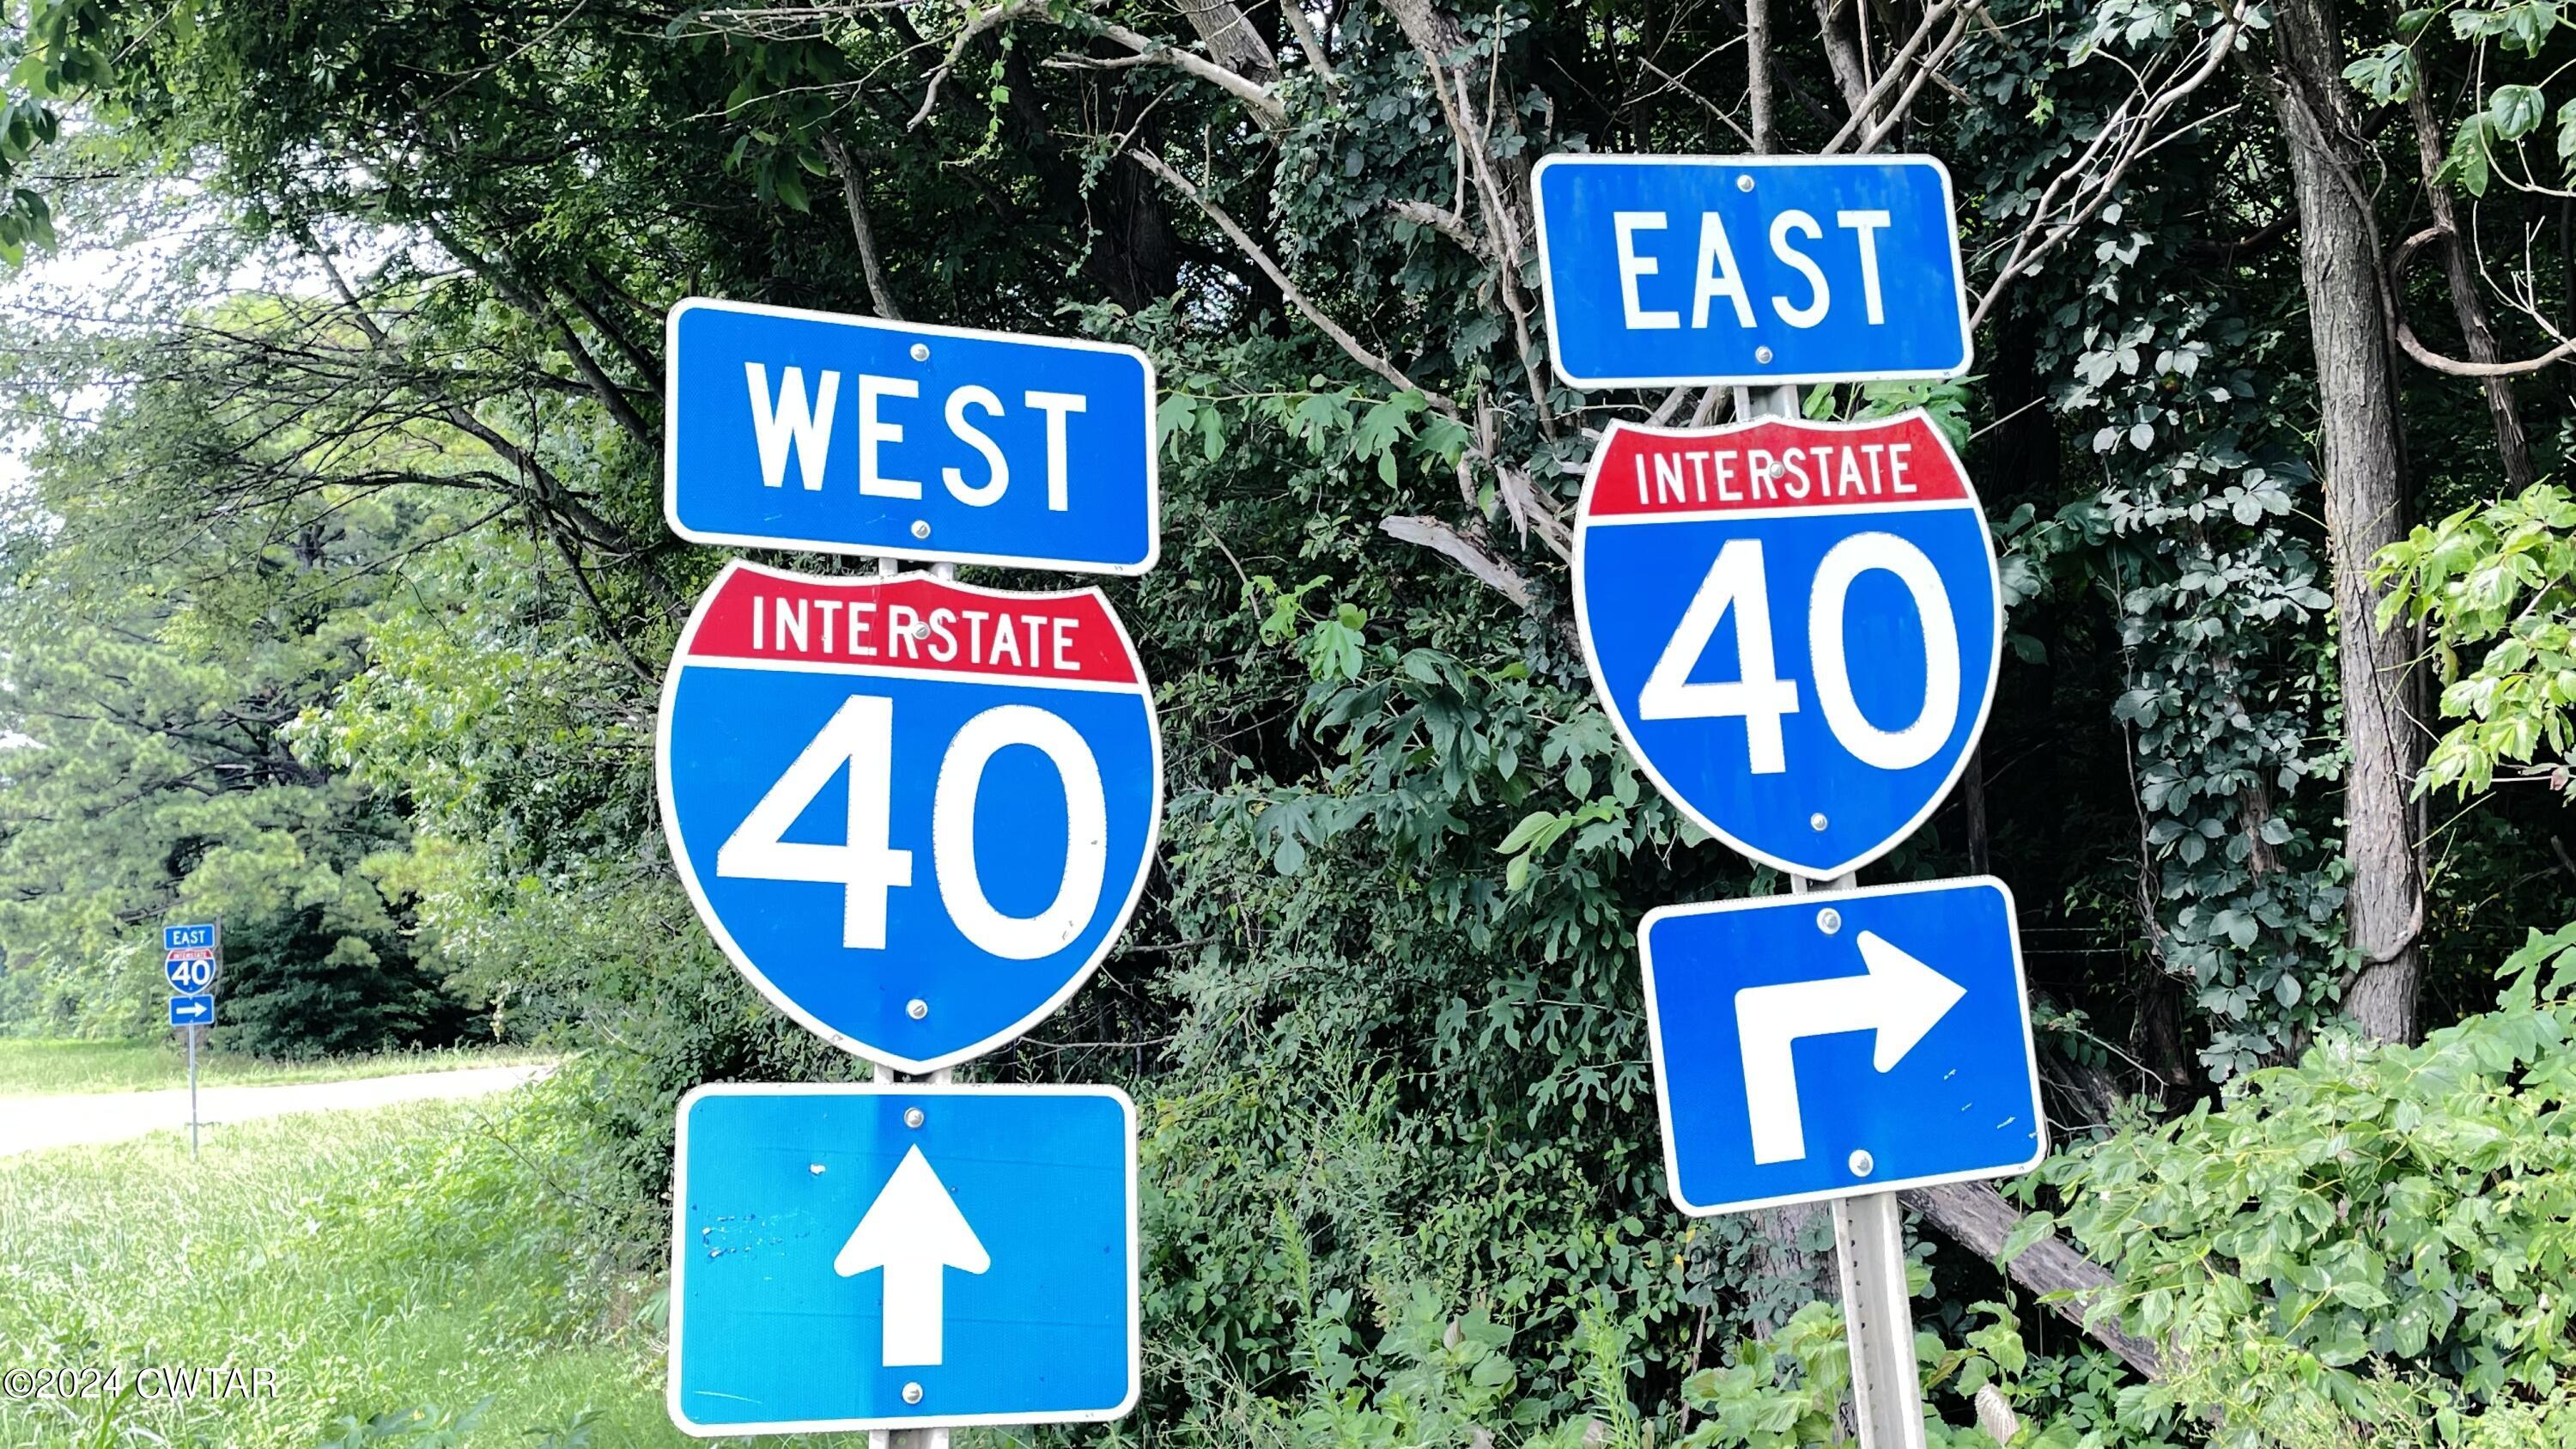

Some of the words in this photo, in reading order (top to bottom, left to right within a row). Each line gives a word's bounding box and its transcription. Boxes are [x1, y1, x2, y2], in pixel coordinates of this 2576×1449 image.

[1613, 210, 1891, 330] EAST
[744, 362, 1087, 512] WEST
[1635, 443, 1917, 505] INTERSTATE
[752, 595, 1081, 671] INTERSTATE
[1638, 531, 1961, 775] 40
[716, 694, 1108, 960] 40
[171, 959, 211, 986] 40
[173, 930, 206, 946] EAST
